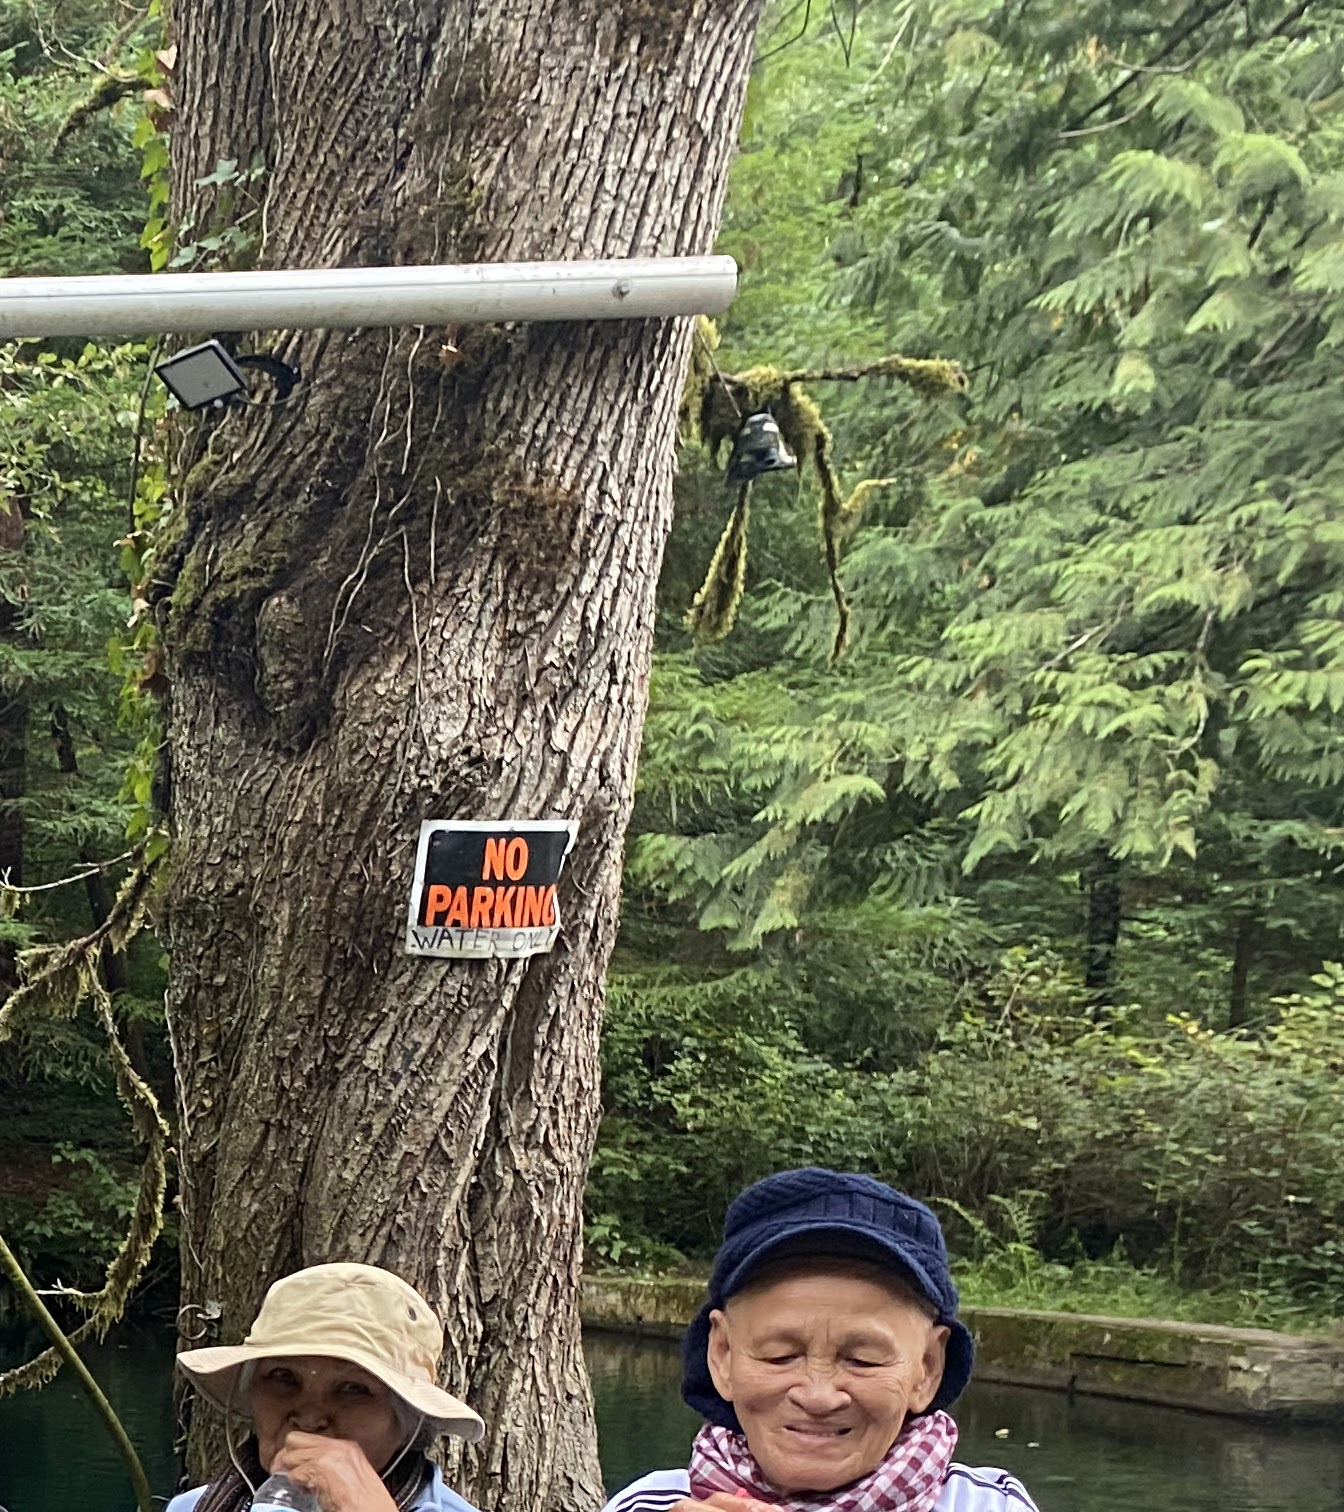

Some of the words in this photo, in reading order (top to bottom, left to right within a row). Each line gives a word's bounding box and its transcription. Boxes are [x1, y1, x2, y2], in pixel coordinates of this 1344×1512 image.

[482, 837, 529, 881] NO
[426, 885, 558, 928] PARKING
[412, 928, 497, 951] WATER
[512, 927, 559, 952] ONLY
